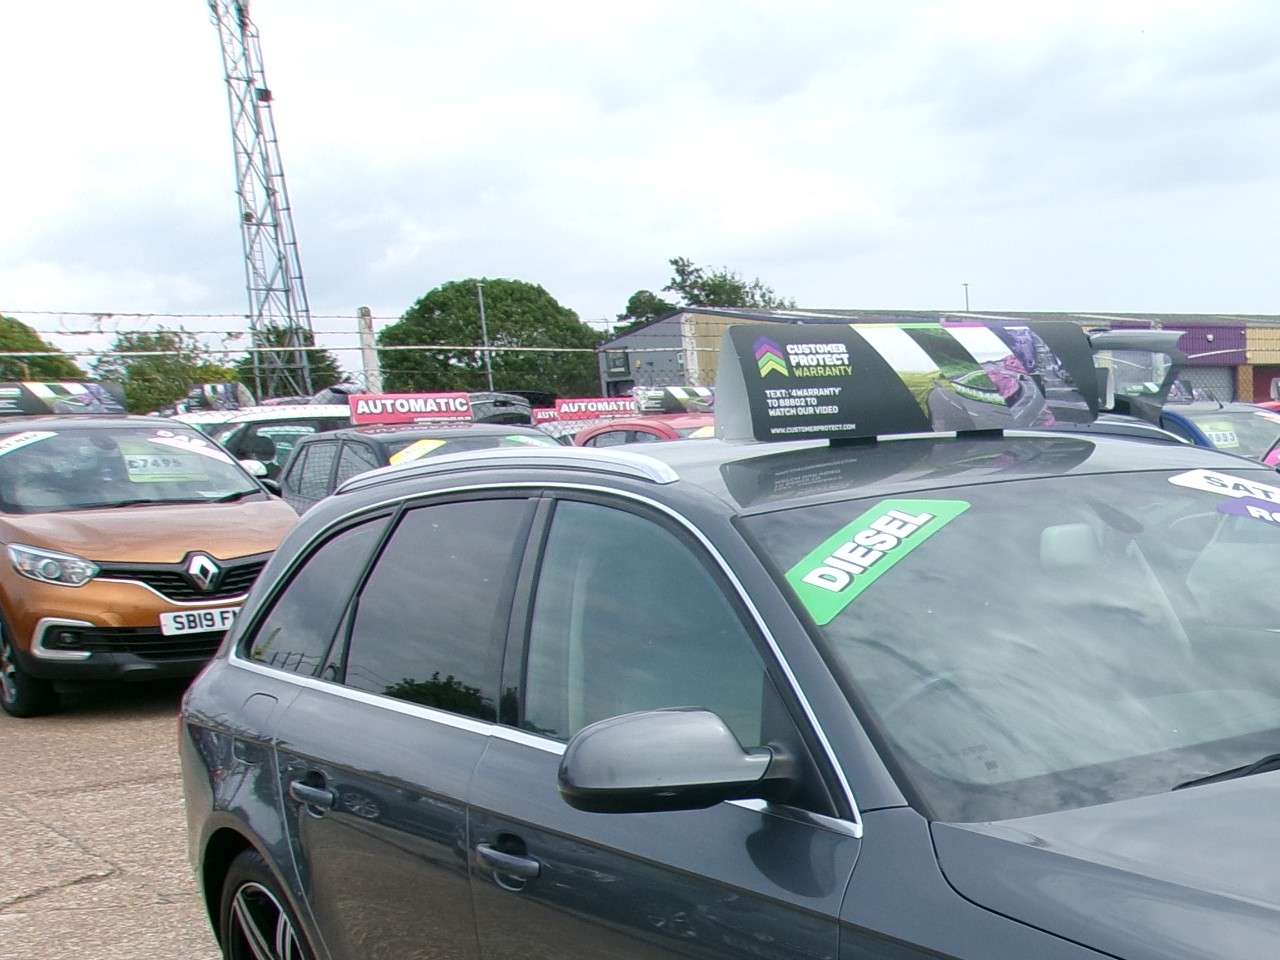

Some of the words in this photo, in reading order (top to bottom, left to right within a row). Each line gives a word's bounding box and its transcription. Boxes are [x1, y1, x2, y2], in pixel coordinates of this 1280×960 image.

[786, 344, 847, 354] CUSTOMER
[788, 354, 849, 366] PROTECT
[793, 366, 852, 377] WARRANTY
[765, 389, 789, 399] TEXT:
[357, 398, 468, 414] AUTOMATIC
[766, 398, 778, 408] TO
[807, 397, 818, 407] TO
[768, 408, 796, 417] WATCH
[797, 407, 815, 416] OUR
[815, 405, 839, 415] VIDEO
[1203, 475, 1275, 499] SAT
[801, 509, 936, 593] DIESEL
[172, 612, 216, 630] SB19
